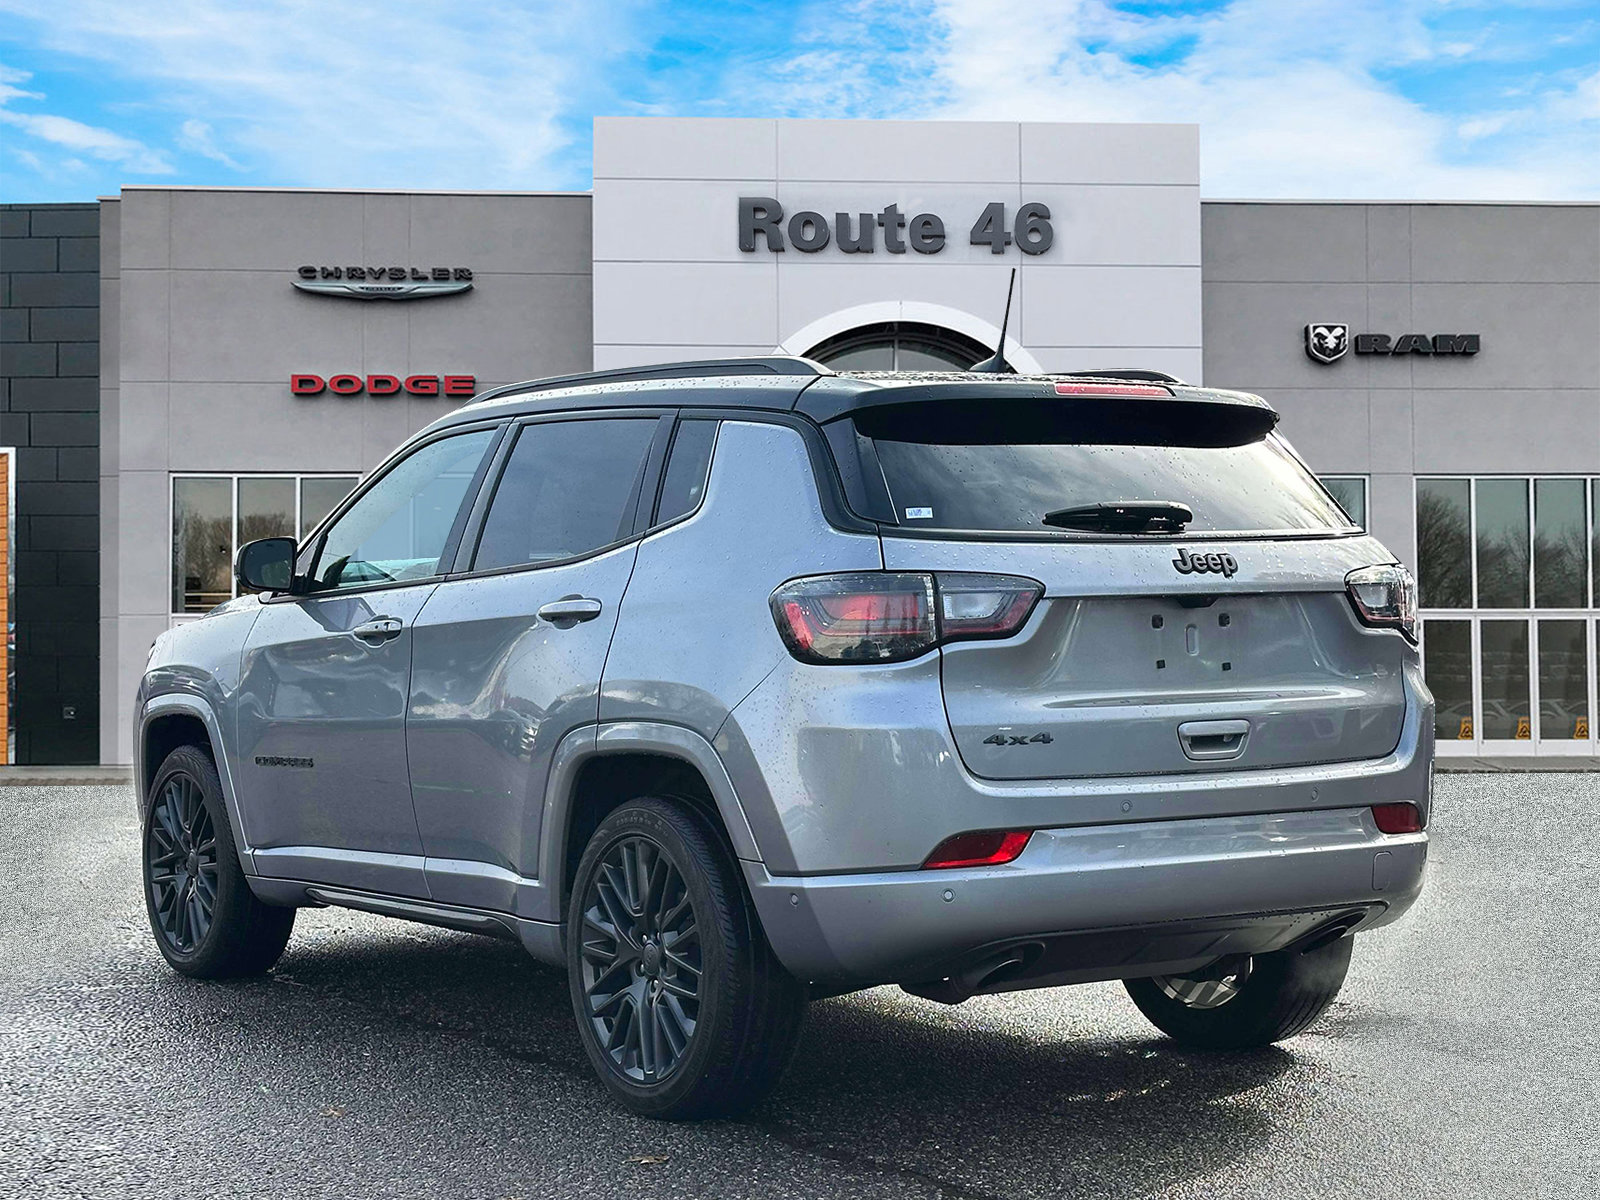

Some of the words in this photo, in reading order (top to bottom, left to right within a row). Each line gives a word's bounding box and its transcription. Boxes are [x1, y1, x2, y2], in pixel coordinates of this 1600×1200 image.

[738, 196, 946, 255] Route
[969, 202, 1055, 256] 46
[298, 266, 474, 281] CHRYSLER
[1354, 333, 1481, 356] RAM
[291, 373, 476, 396] DODGE
[1172, 547, 1239, 578] Jeep
[983, 731, 1054, 746] 4x4
